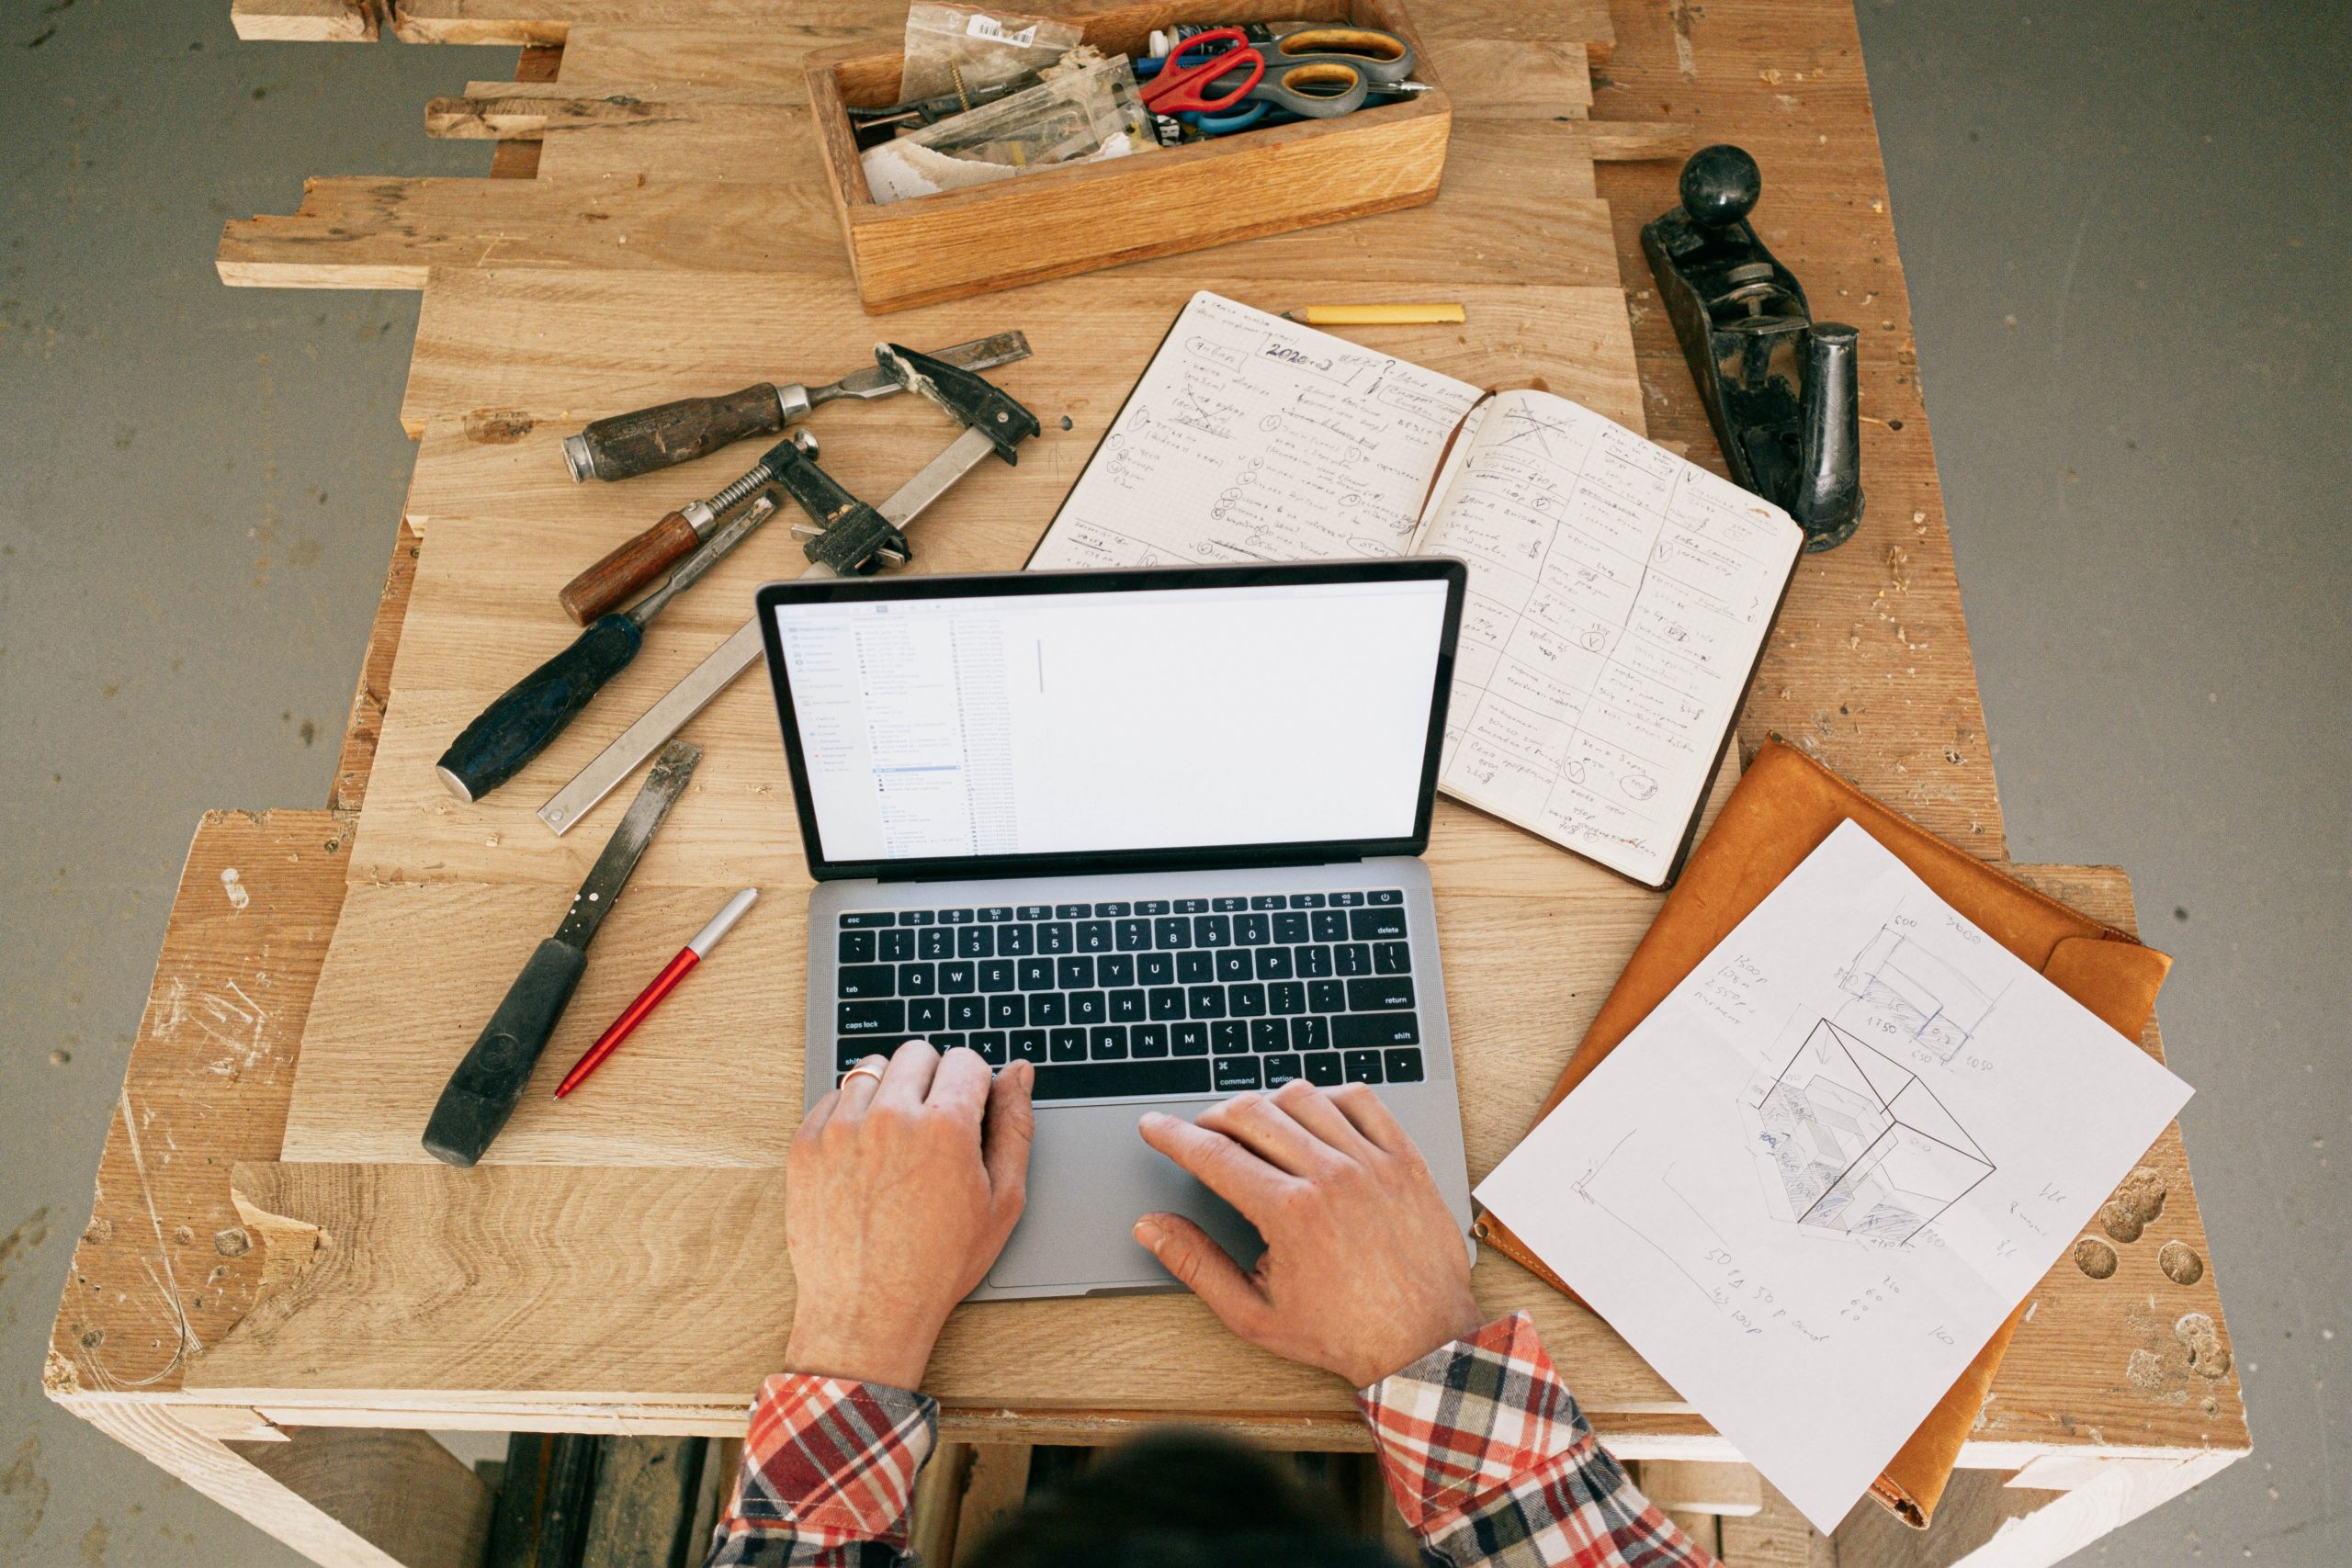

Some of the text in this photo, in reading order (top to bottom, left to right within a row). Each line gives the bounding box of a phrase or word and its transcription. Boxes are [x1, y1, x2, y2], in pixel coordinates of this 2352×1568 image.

[895, 946, 899, 954] 1
[933, 944, 940, 953] 2
[973, 942, 979, 951] 3
[1012, 941, 1019, 949] 4
[1052, 939, 1058, 948] 5
[1091, 937, 1098, 946] 6
[1131, 936, 1136, 944] 7
[1170, 934, 1177, 942] 8
[1209, 932, 1216, 941] 9
[1249, 931, 1256, 939] 0
[913, 975, 921, 984] Q
[952, 973, 962, 981] W
[993, 971, 1000, 979] E
[1033, 969, 1039, 978] R
[1073, 967, 1080, 976] T
[1112, 966, 1119, 975] Y
[1151, 964, 1159, 973] U
[1231, 960, 1238, 969] O
[1271, 959, 1277, 967] P
[1311, 950, 1315, 960] {
[1350, 948, 1354, 958] }
[1312, 963, 1316, 973] [
[1351, 961, 1356, 970] ]
[923, 1010, 931, 1018] A
[964, 1008, 970, 1017] S
[1003, 1007, 1011, 1015] D
[1044, 1005, 1050, 1013] F
[1083, 1002, 1091, 1011] G
[1124, 1001, 1131, 1010] H
[1165, 999, 1170, 1008] J
[1203, 998, 1210, 1006] K
[1244, 996, 1250, 1004] L
[984, 1043, 990, 1052] X
[1024, 1042, 1032, 1051] C
[1065, 1040, 1072, 1049] V
[1105, 1038, 1113, 1047] B
[1146, 1036, 1153, 1044] N
[1185, 1034, 1194, 1043] M
[1306, 1021, 1312, 1031] ?
[1308, 1033, 1312, 1043] /
[1270, 1075, 1295, 1084] option
